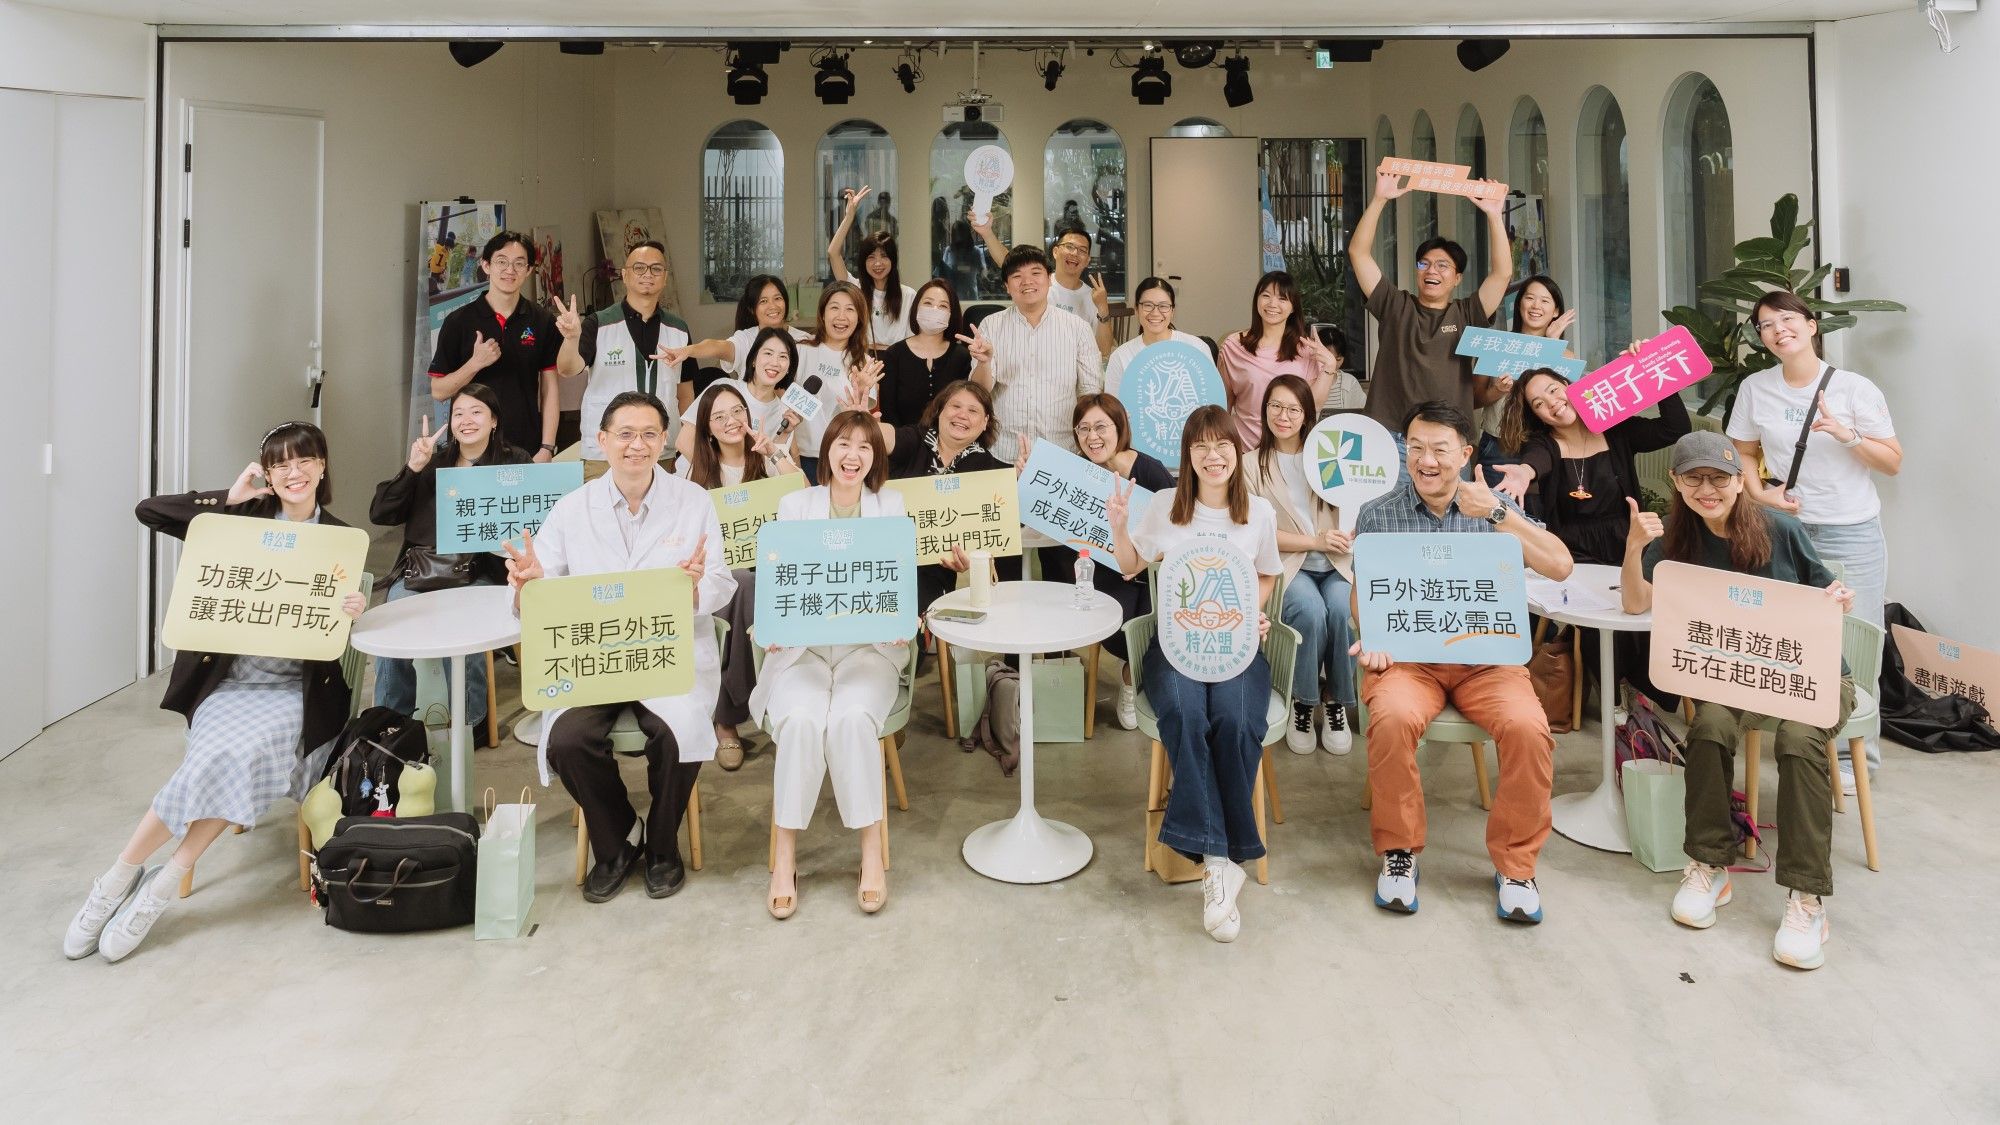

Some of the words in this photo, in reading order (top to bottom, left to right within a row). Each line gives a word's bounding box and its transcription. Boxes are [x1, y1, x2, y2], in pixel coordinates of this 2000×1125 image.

[1470, 334, 1544, 357] #我遊戲
[1581, 349, 1692, 421] 親子天下
[787, 387, 818, 417] 特公盟
[1155, 420, 1184, 440] 特公
[1349, 464, 1386, 478] TILA
[1030, 470, 1108, 521] 戶外遊玩
[907, 502, 1001, 529] 課少一點
[261, 530, 297, 549] 特公盟
[916, 529, 1010, 556] 我出門玩!
[197, 563, 338, 598] 功課少一點
[775, 560, 898, 587] 親子出門玩
[592, 583, 625, 600] 特公盟
[774, 590, 899, 617] 手機不成癮
[1369, 578, 1499, 603] 戶外遊玩是
[1728, 585, 1763, 607] 特公盟
[189, 595, 339, 637] 讓我出門玩!
[1387, 609, 1517, 635] 成長必需品
[543, 614, 676, 649] 下課戶外玩
[1185, 630, 1233, 655] 特公盟
[1687, 620, 1803, 666] 盡情遊戲
[544, 645, 676, 681] 不怕近視來
[1671, 648, 1818, 701] 玩在起跑點
[1914, 667, 1986, 707] 盡情遊戲
